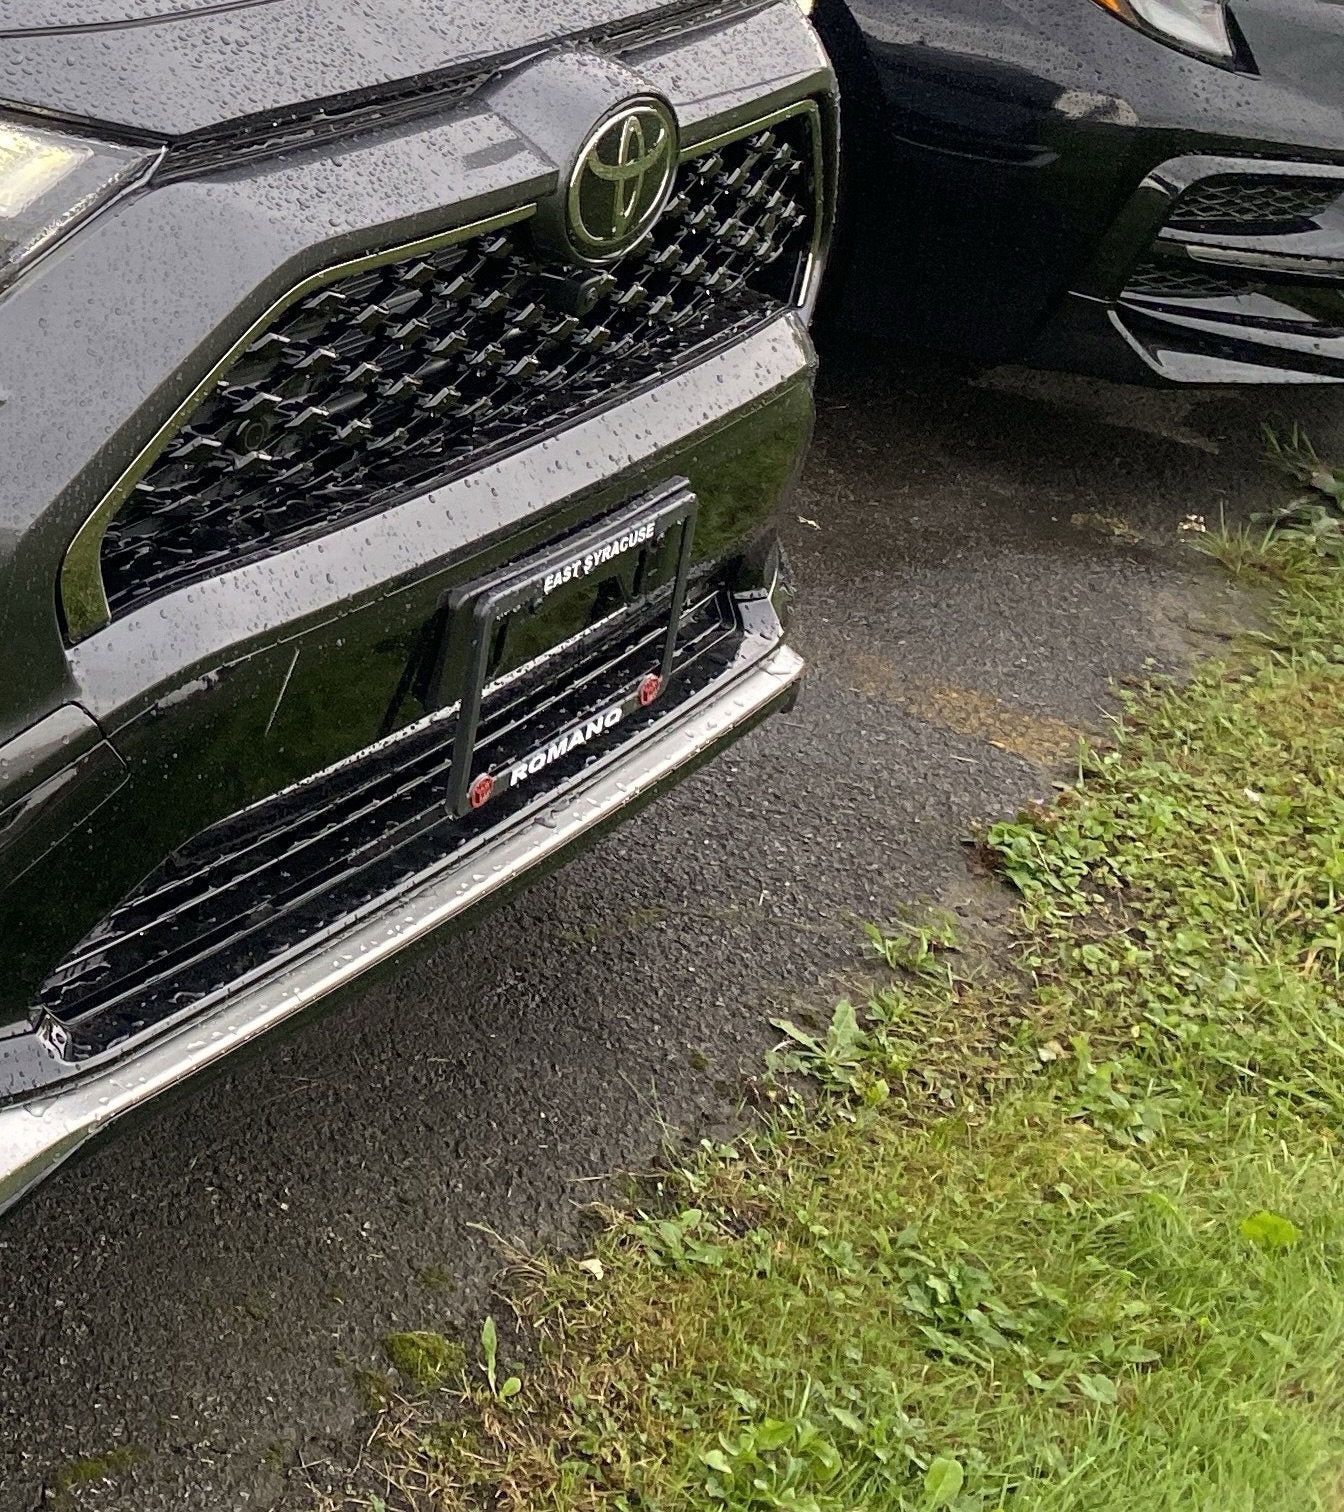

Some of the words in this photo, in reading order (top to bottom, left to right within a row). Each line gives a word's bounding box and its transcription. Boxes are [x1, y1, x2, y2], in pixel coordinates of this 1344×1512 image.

[543, 560, 582, 595] EAST
[583, 521, 656, 575] SYRACUSE
[509, 707, 623, 786] ROMANO
